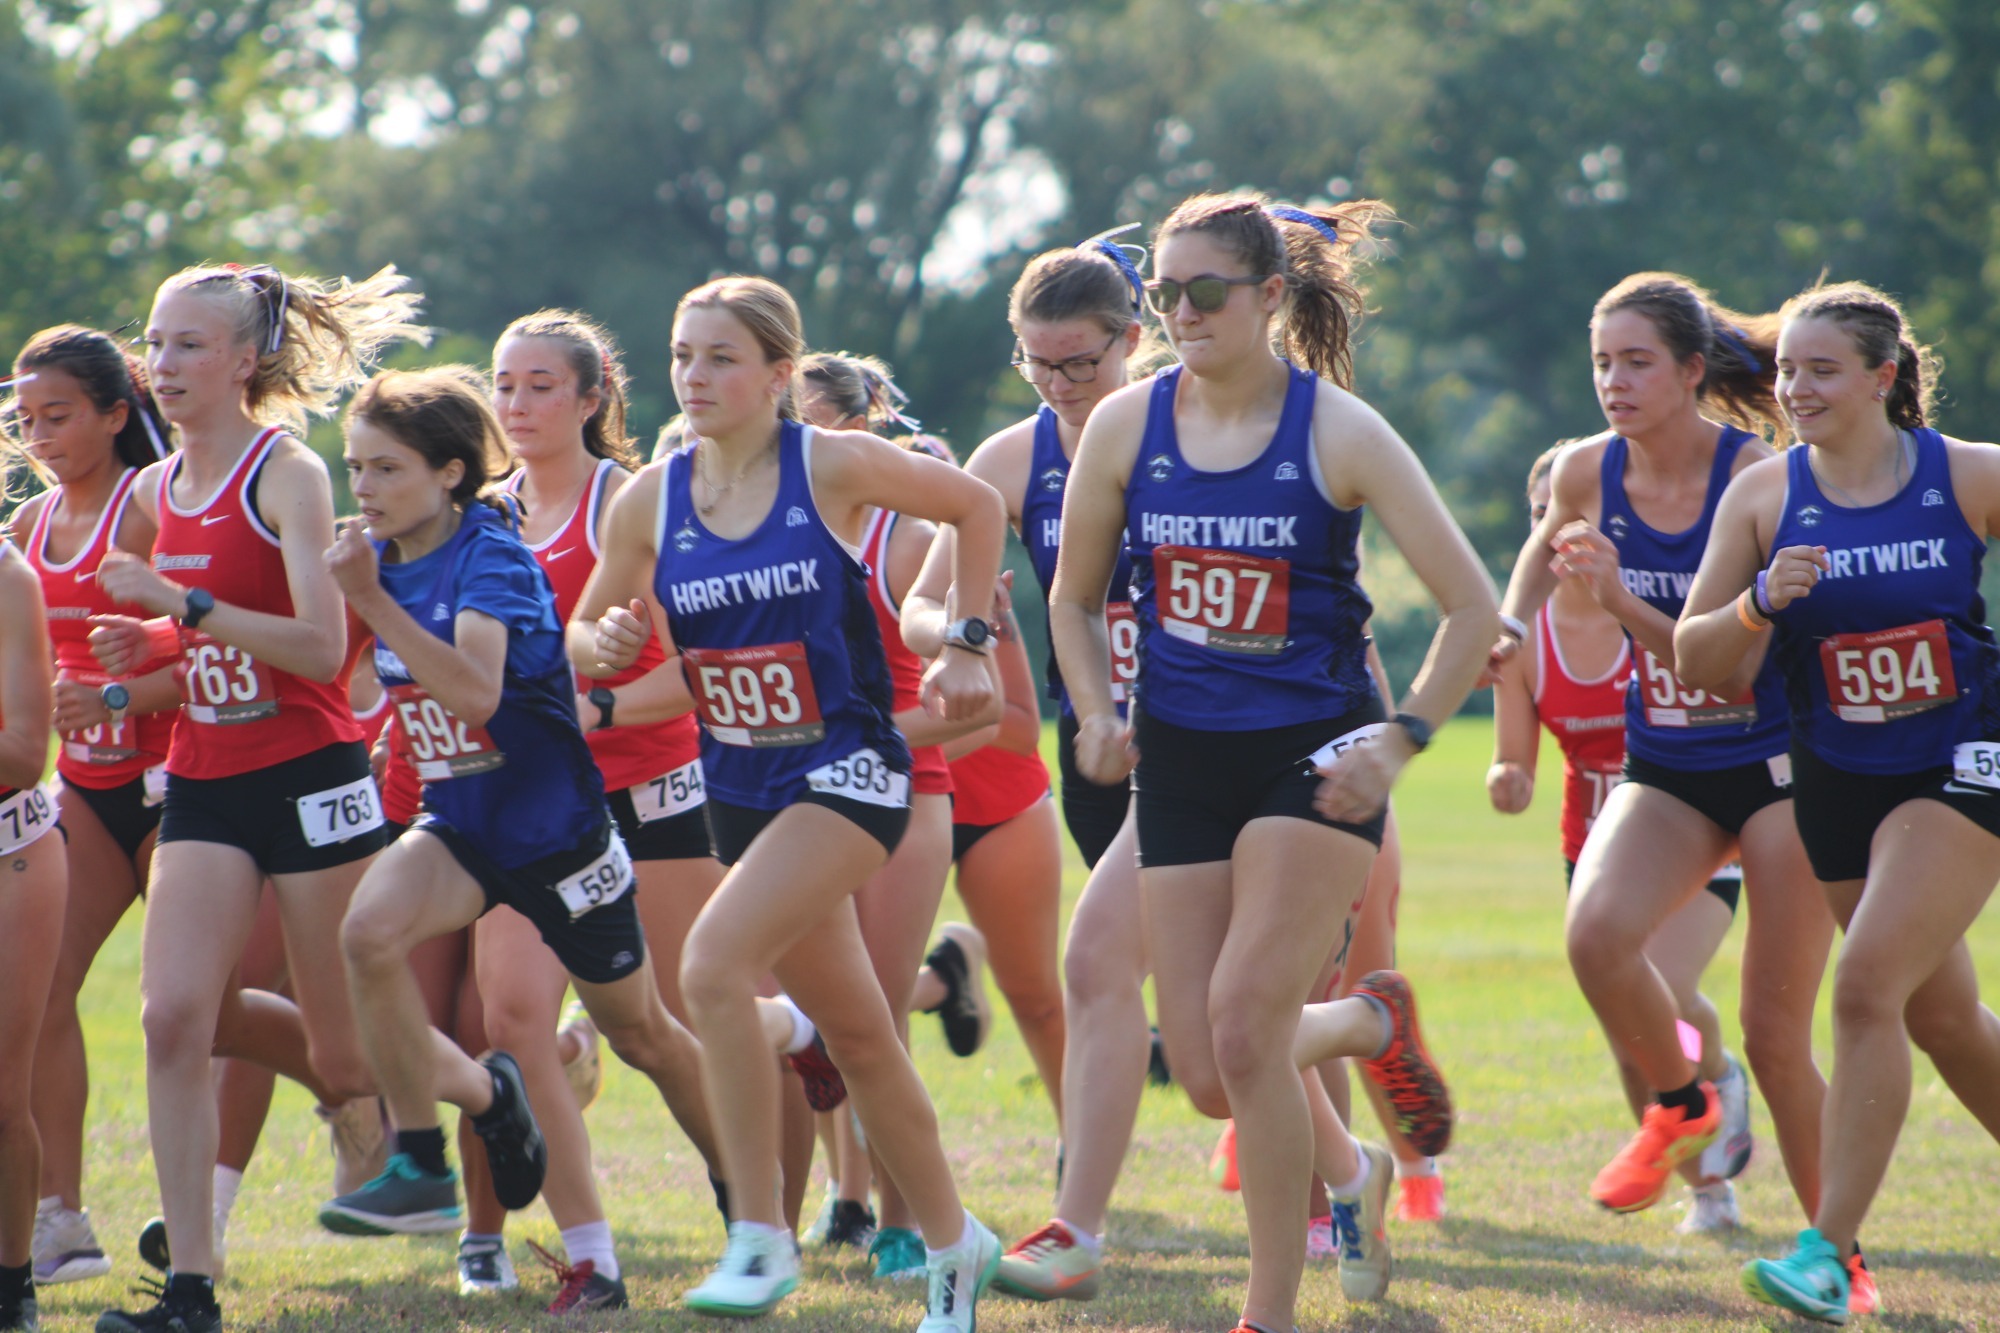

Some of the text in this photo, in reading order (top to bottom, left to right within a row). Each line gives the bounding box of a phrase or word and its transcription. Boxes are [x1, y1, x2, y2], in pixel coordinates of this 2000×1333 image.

[1142, 512, 1298, 547] HARTWICK
[1815, 538, 1948, 580] ARTWICK
[671, 558, 821, 615] HARTWICK
[1169, 560, 1272, 630] 597
[186, 645, 259, 705] 763
[699, 663, 802, 727] 593
[1835, 640, 1941, 704] 594
[398, 699, 482, 760] 592
[650, 765, 701, 808] 754
[830, 757, 889, 793] 593
[2, 789, 49, 839] 749
[319, 789, 372, 831] 763
